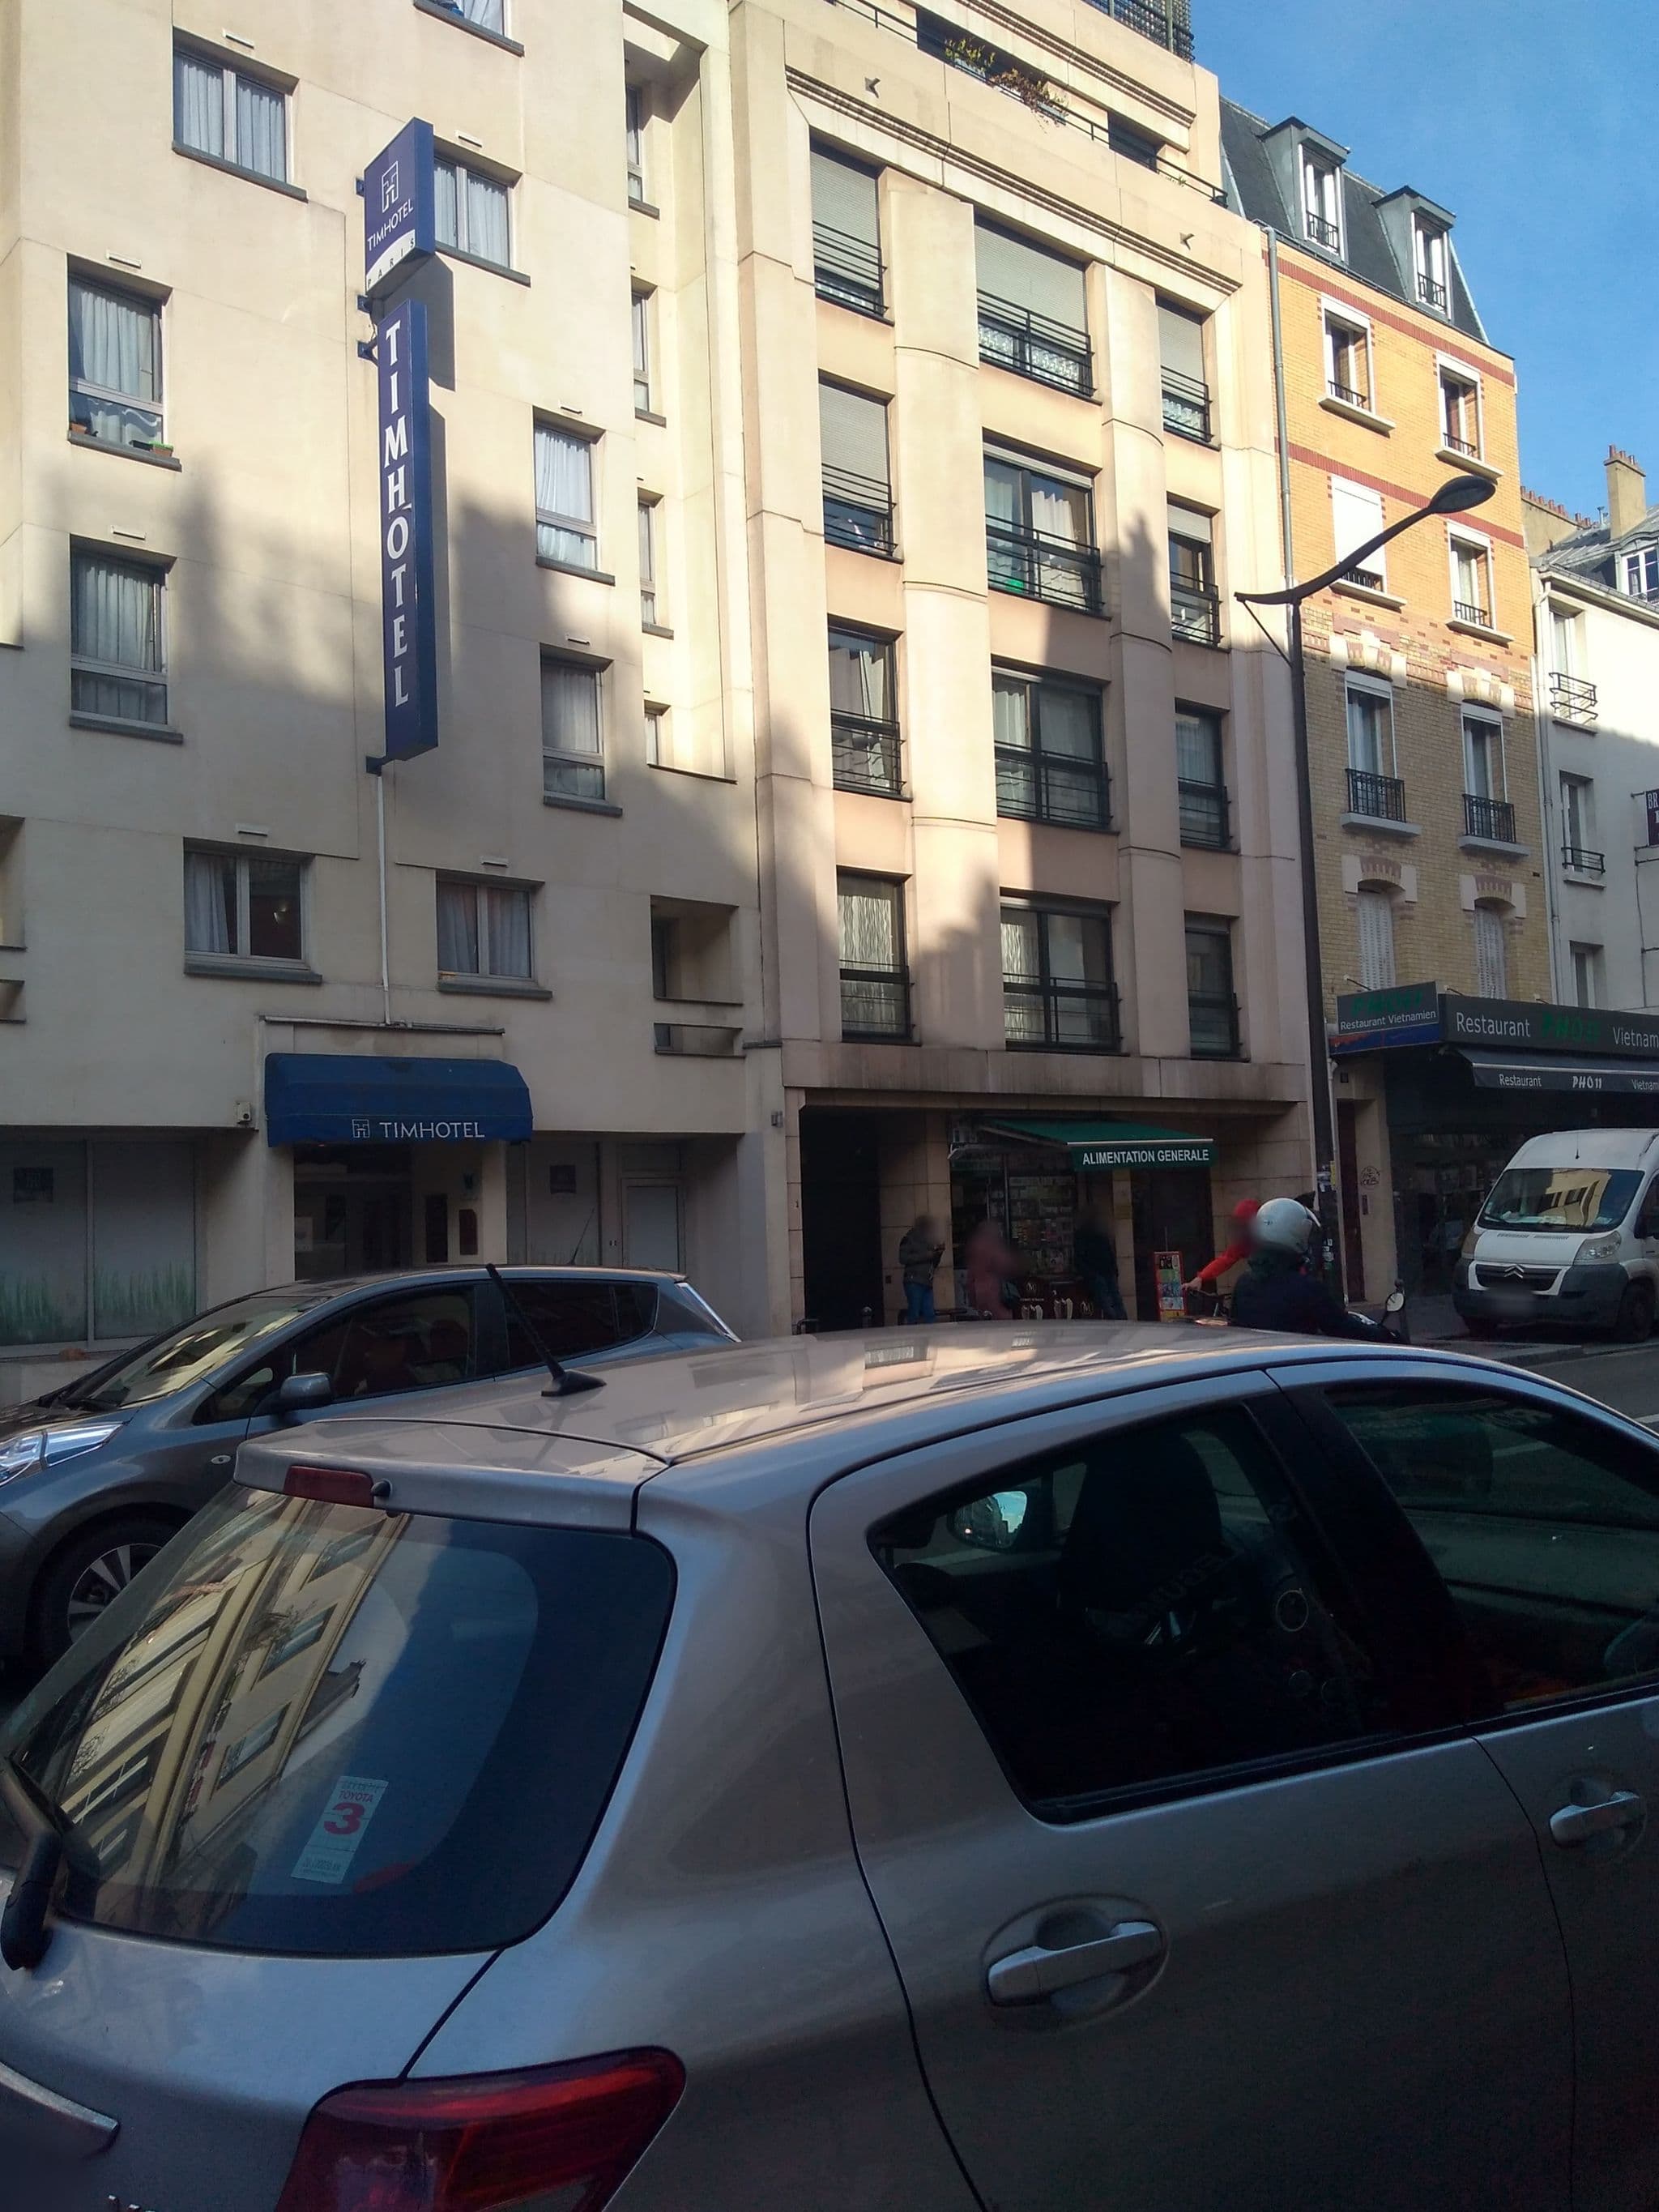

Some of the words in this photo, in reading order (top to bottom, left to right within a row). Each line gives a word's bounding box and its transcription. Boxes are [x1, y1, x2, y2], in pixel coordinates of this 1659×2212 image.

[367, 199, 414, 252] TIMHOTEL
[368, 238, 414, 288] PARIS
[384, 320, 409, 707] TIMHOTEL
[1341, 1016, 1386, 1031] Restaurant
[1388, 1010, 1436, 1024] Vietnamien
[1456, 1011, 1531, 1038] Restaurant
[1499, 1073, 1542, 1087] Restaurant
[379, 1121, 485, 1138] TIMHOTEL
[1082, 1151, 1155, 1165] ALIMENTATION
[1157, 1149, 1209, 1162] GENERALE
[338, 1789, 374, 1803] TOYOTA
[324, 1802, 366, 1835] 3
